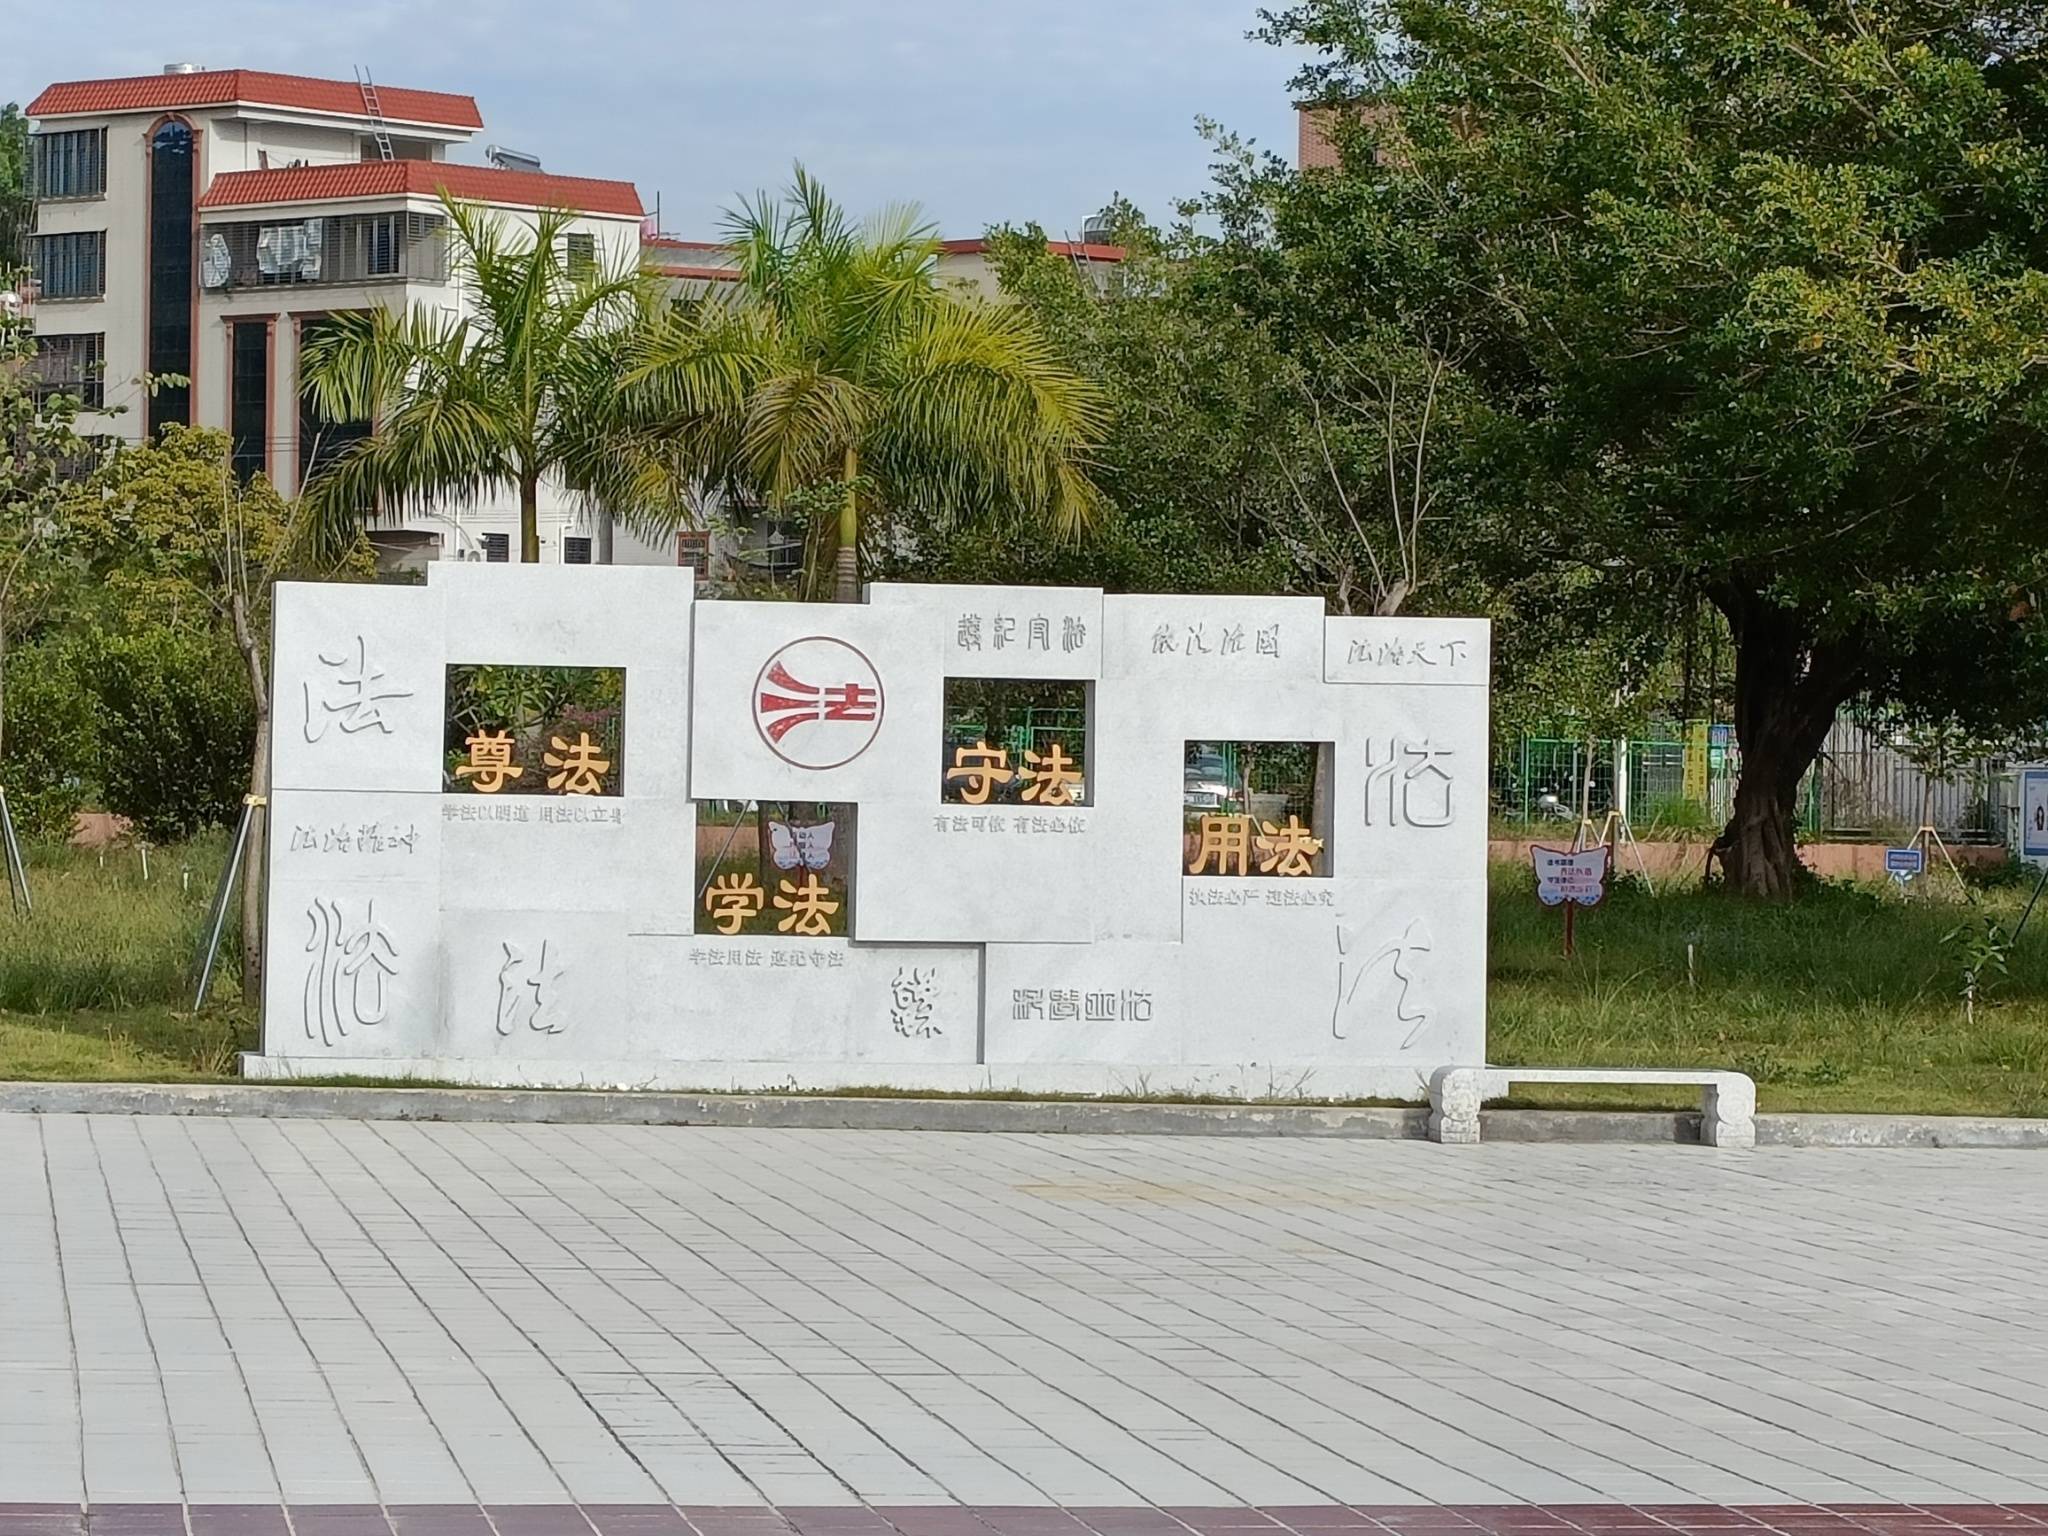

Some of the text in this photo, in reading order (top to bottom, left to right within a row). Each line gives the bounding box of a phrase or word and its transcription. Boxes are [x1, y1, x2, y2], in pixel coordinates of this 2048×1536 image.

[455, 730, 610, 797] 尊法
[946, 740, 1084, 806] 守法
[441, 803, 529, 823] 学法以明道
[933, 815, 1086, 835] 有法可依 有法必依
[1188, 813, 1320, 877] 用法
[704, 871, 840, 936] 学法
[1265, 888, 1335, 907] 违法必究
[688, 947, 844, 969] 学法用法 遵纪守法
